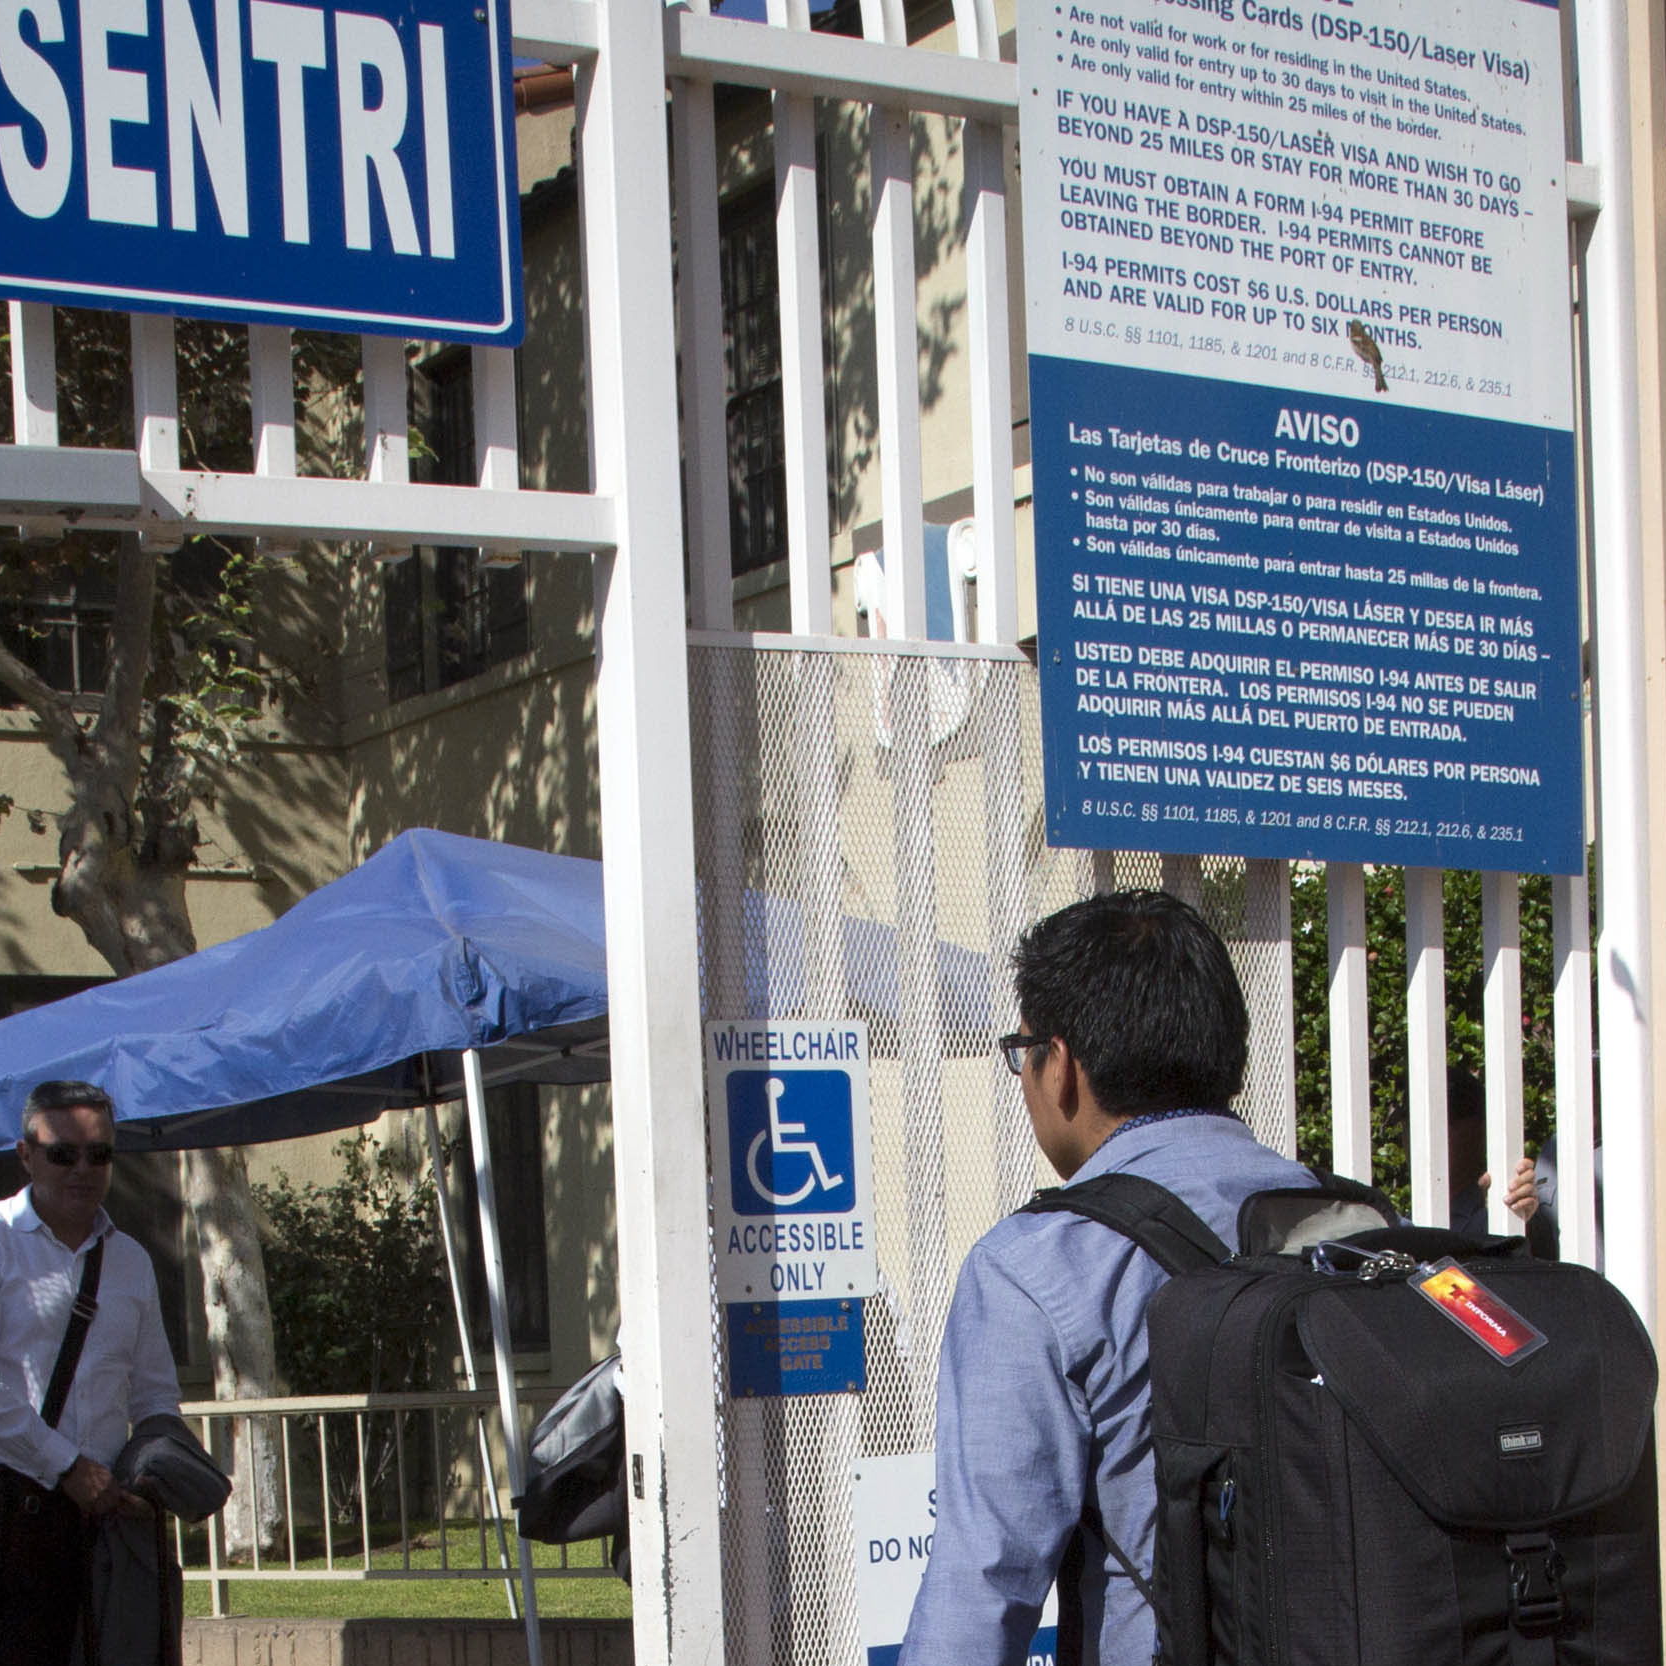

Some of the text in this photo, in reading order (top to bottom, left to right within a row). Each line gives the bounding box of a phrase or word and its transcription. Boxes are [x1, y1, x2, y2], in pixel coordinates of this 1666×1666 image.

[1069, 5, 1471, 102] Are not valid for work or for residing in the United States.
[1242, 0, 1303, 31] Cards
[1482, 50, 1530, 85] Visa)
[1057, 89, 1521, 194] IF YOU HAVE A DSP-150/LASER VISA AND WISH TO GO
[1275, 409, 1360, 448] AVISO
[1069, 422, 1103, 446] Las
[1108, 427, 1183, 456] Tarjetas
[1188, 438, 1211, 460] de
[1217, 441, 1269, 467] Cruce
[1275, 449, 1361, 479] Fronterizo
[1495, 478, 1544, 507] Láser)
[1078, 735, 1540, 787] LOS PERMISOS I-94 CUESTAN $6 DÓLARES POR PERSONA
[713, 1031, 859, 1062] WHEELCHAIR
[728, 1221, 864, 1255] ACCESSIBLE
[770, 1262, 826, 1293] ONLY
[780, 1353, 823, 1372] GATE
[869, 1538, 901, 1563] DO
